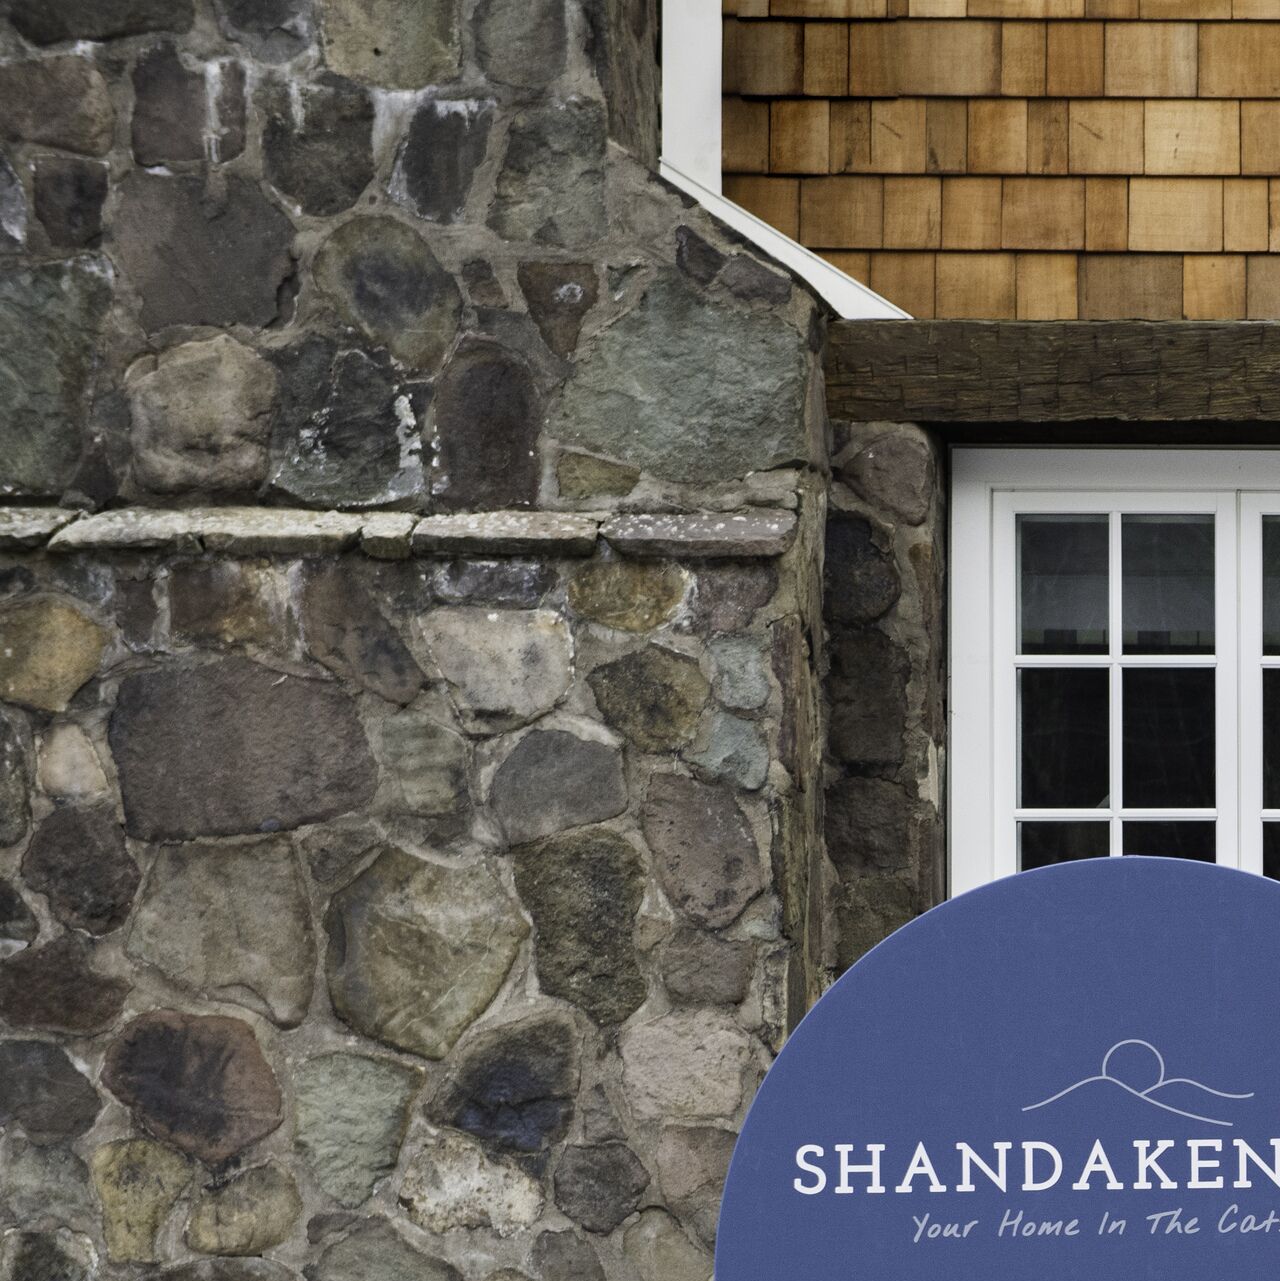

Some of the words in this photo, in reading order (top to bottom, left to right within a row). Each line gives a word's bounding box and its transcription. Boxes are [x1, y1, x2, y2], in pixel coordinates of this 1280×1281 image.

[912, 1212, 979, 1244] Your
[997, 1208, 1081, 1237] Home
[1098, 1211, 1127, 1236] In
[1146, 1207, 1201, 1236] The
